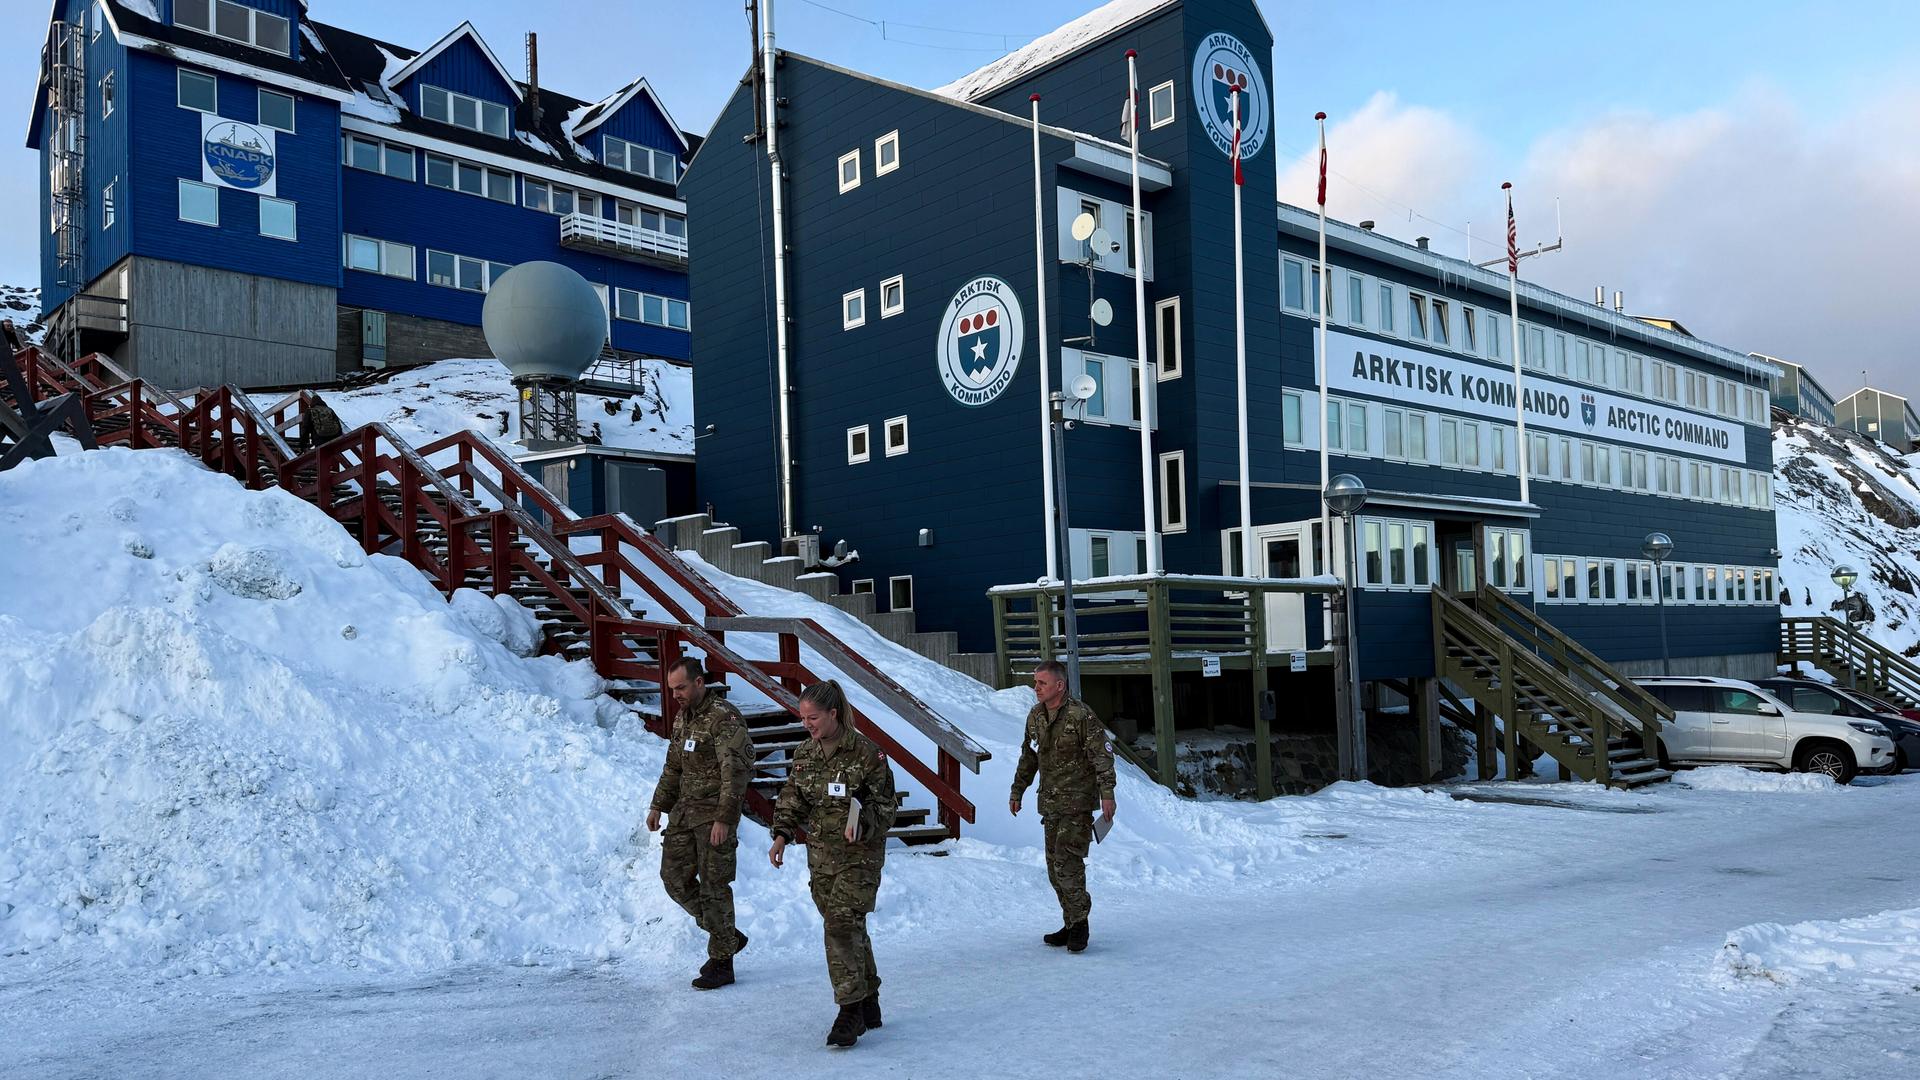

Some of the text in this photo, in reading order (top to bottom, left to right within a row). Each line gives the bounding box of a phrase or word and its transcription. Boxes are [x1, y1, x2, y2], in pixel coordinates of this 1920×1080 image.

[1208, 35, 1251, 63] ARKTISK
[207, 143, 273, 167] KNAPK
[1205, 120, 1260, 158] KOMNDO
[953, 279, 1002, 309] ARKTISK
[950, 369, 1011, 404] KOMMANDO
[1352, 351, 1730, 450] ARKTISK KOMMANDO ARCTIC COMMAND
